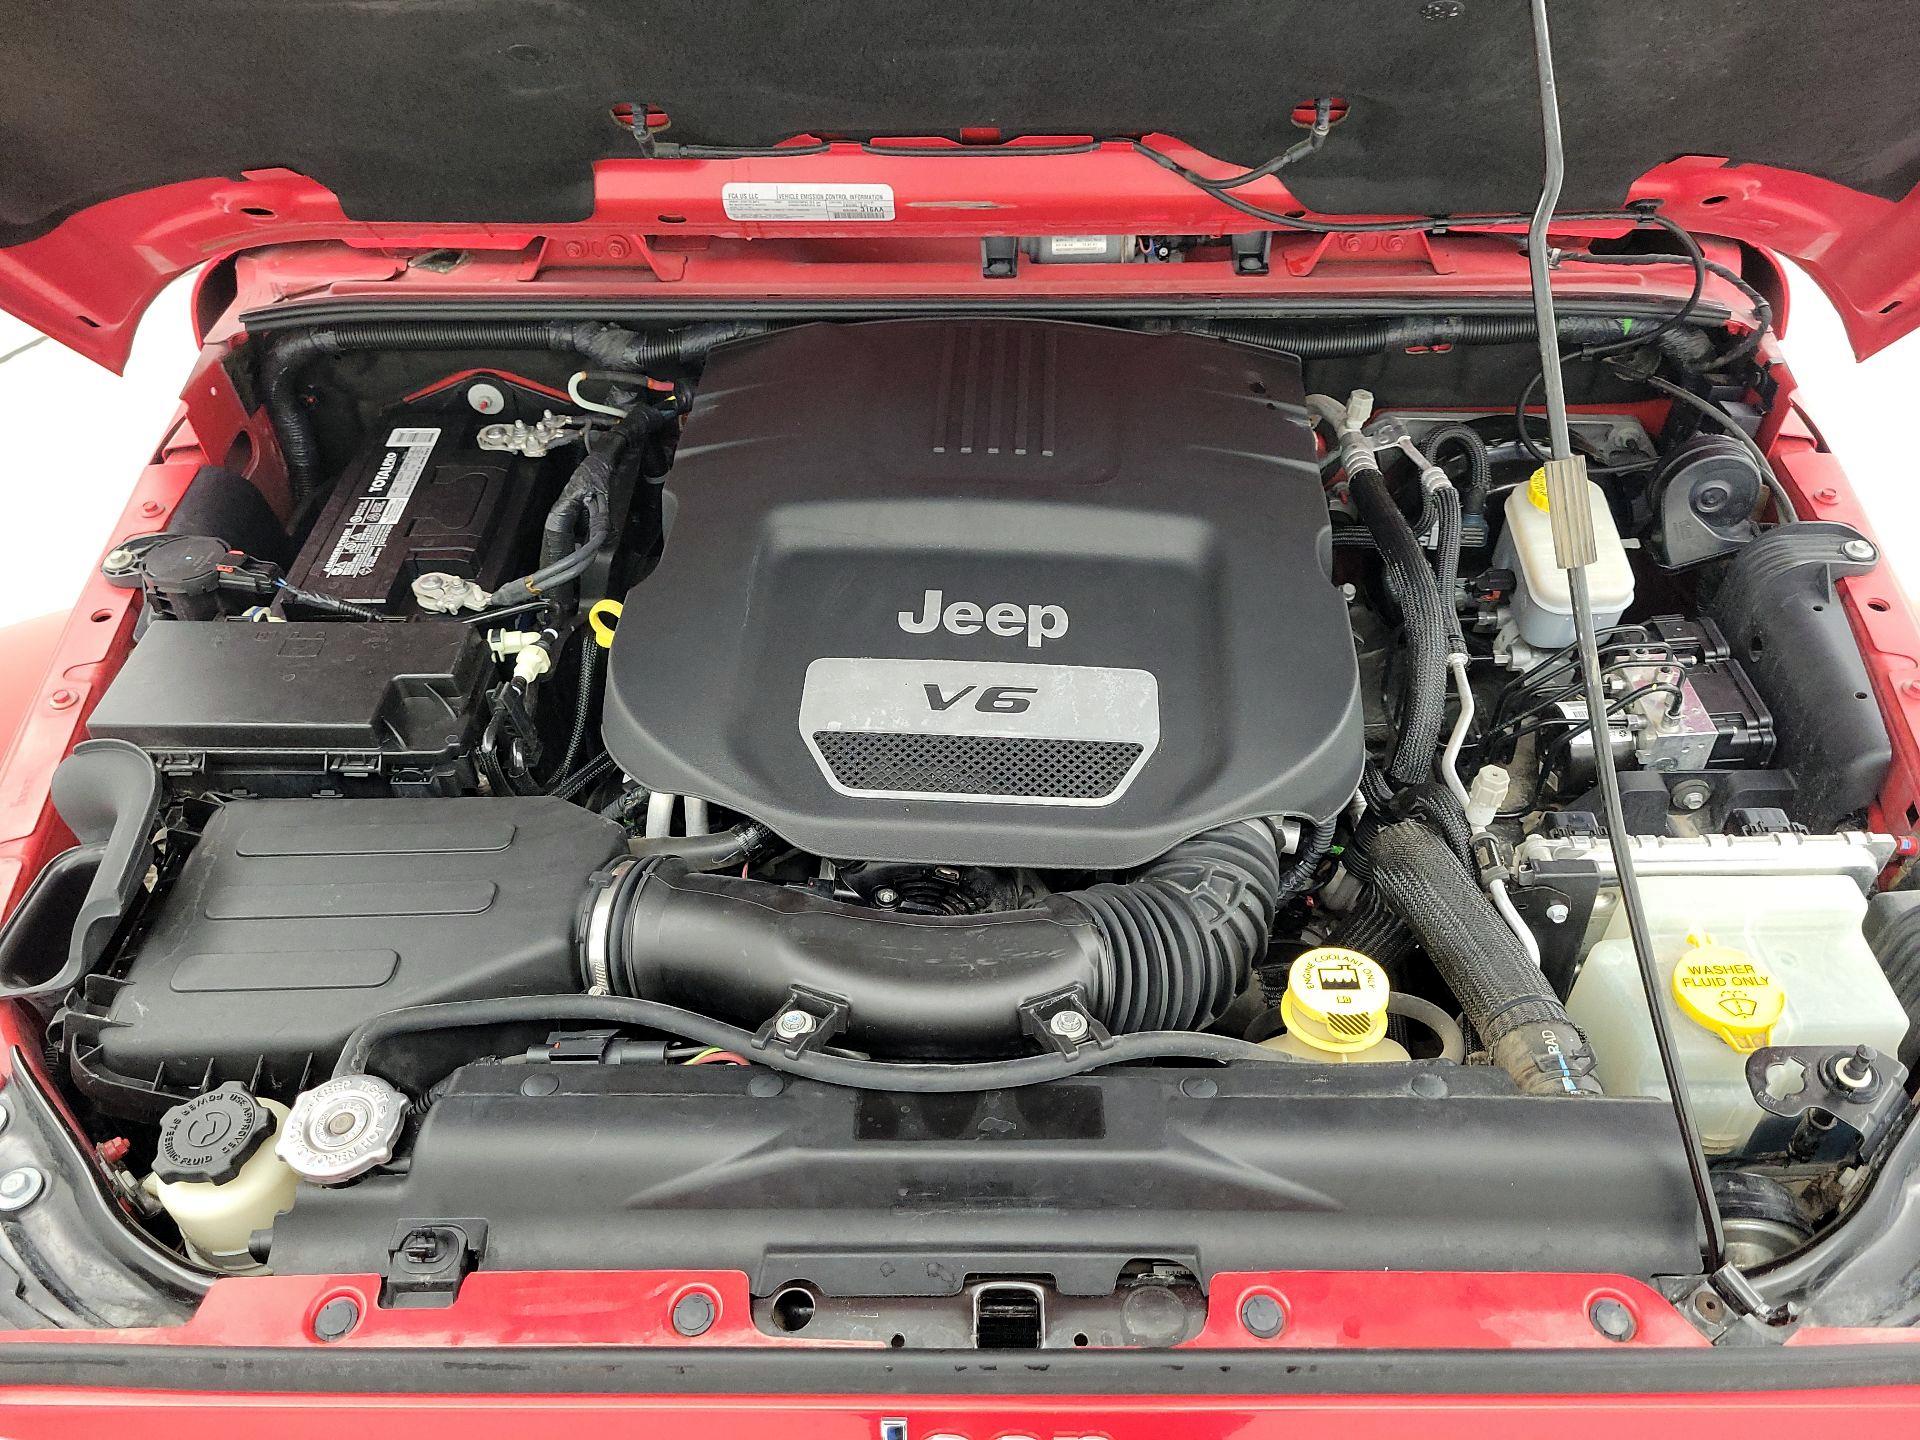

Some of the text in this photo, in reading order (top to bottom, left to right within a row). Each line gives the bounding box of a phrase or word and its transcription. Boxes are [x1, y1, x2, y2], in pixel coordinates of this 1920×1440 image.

[778, 193, 799, 201] VEHICLE
[800, 193, 824, 201] EMISSION
[368, 452, 398, 493] TOTALPRO
[898, 589, 1069, 648] Jeep
[923, 683, 1039, 713] V6
[1303, 953, 1376, 990] ENGINE COOLANT ONLY
[1688, 964, 1756, 975] WASHER
[1682, 976, 1769, 988] FLUID ONLY
[1541, 1030, 1561, 1054] RAD
[181, 1093, 224, 1117] POWER
[229, 1093, 248, 1107] USE
[179, 1155, 214, 1166] FLUID
